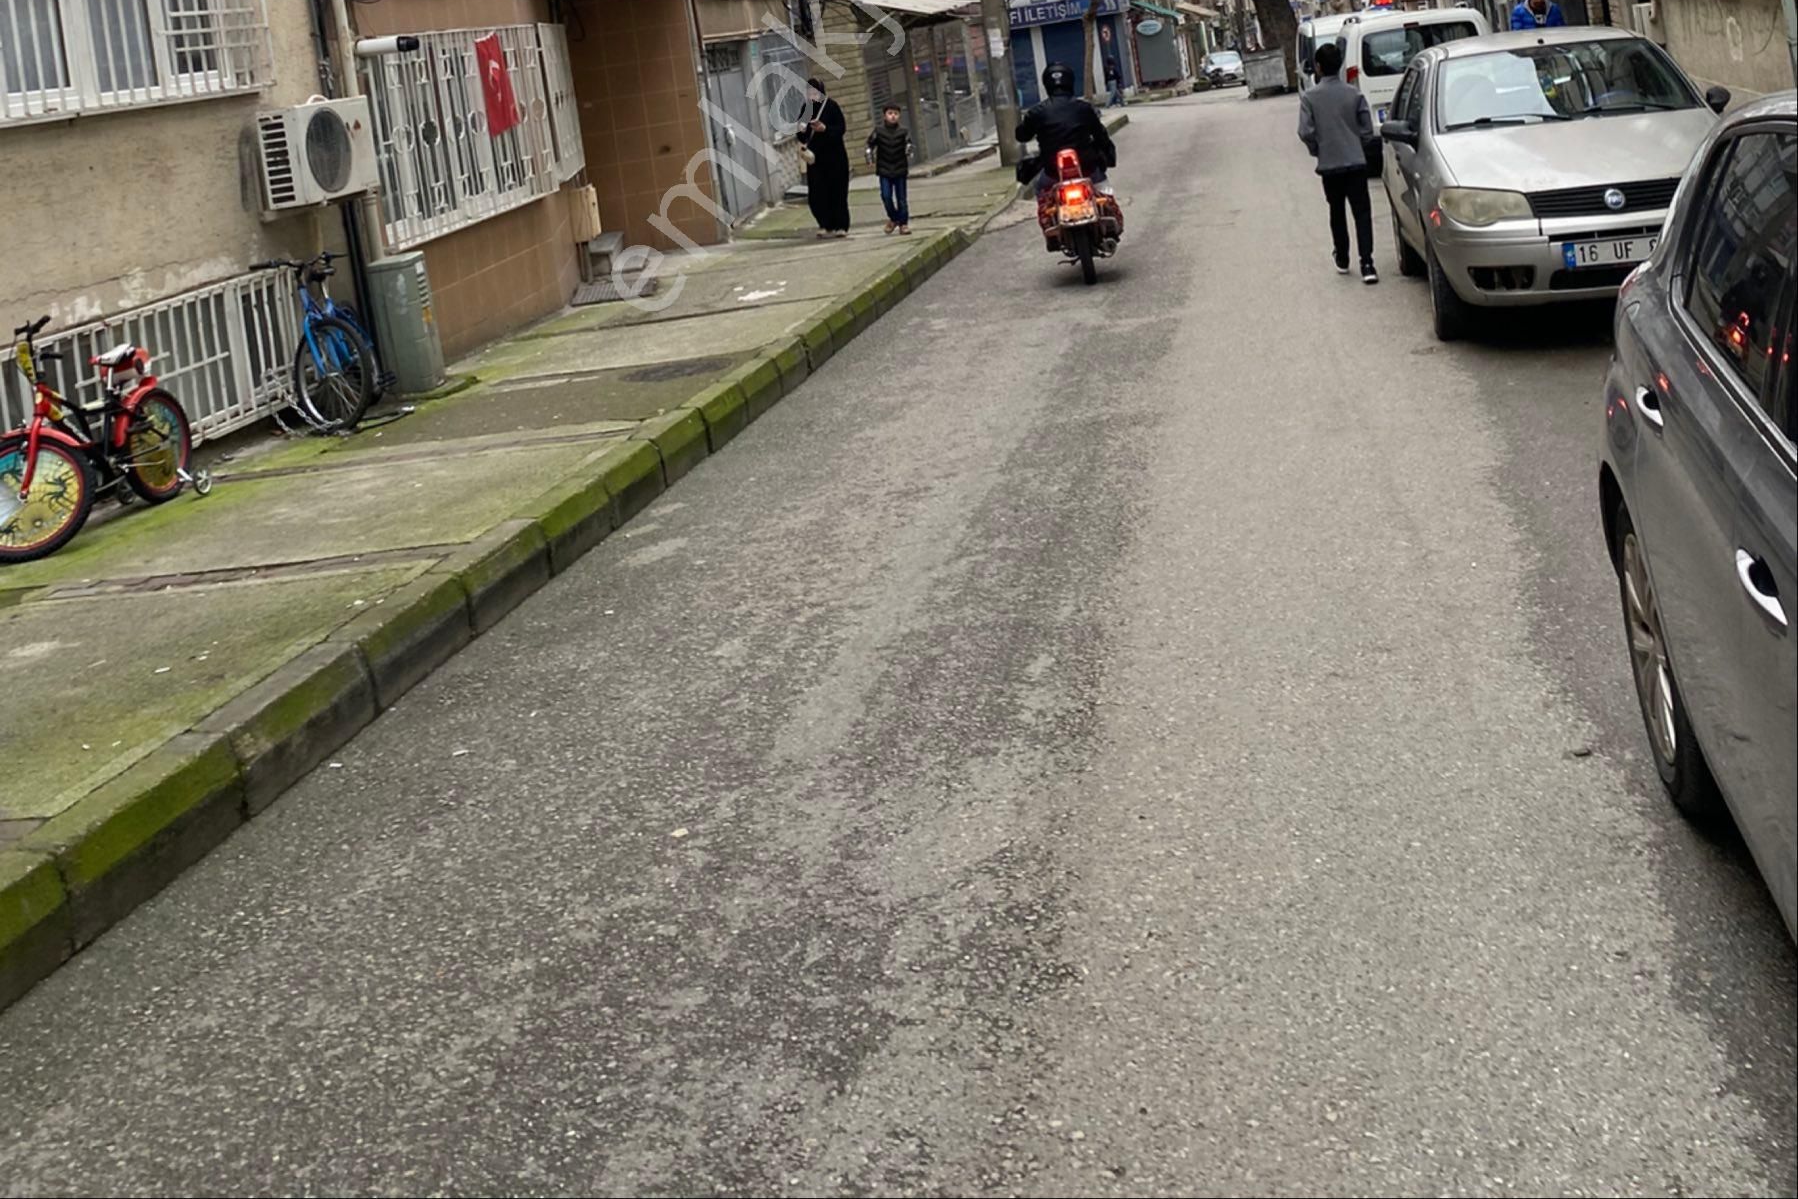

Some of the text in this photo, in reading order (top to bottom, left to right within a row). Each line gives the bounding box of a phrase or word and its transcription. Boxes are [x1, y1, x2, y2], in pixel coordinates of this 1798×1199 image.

[1024, 2, 1081, 22] İLETİŞİM
[1580, 244, 1599, 263] 16
[1613, 241, 1634, 260] UF
